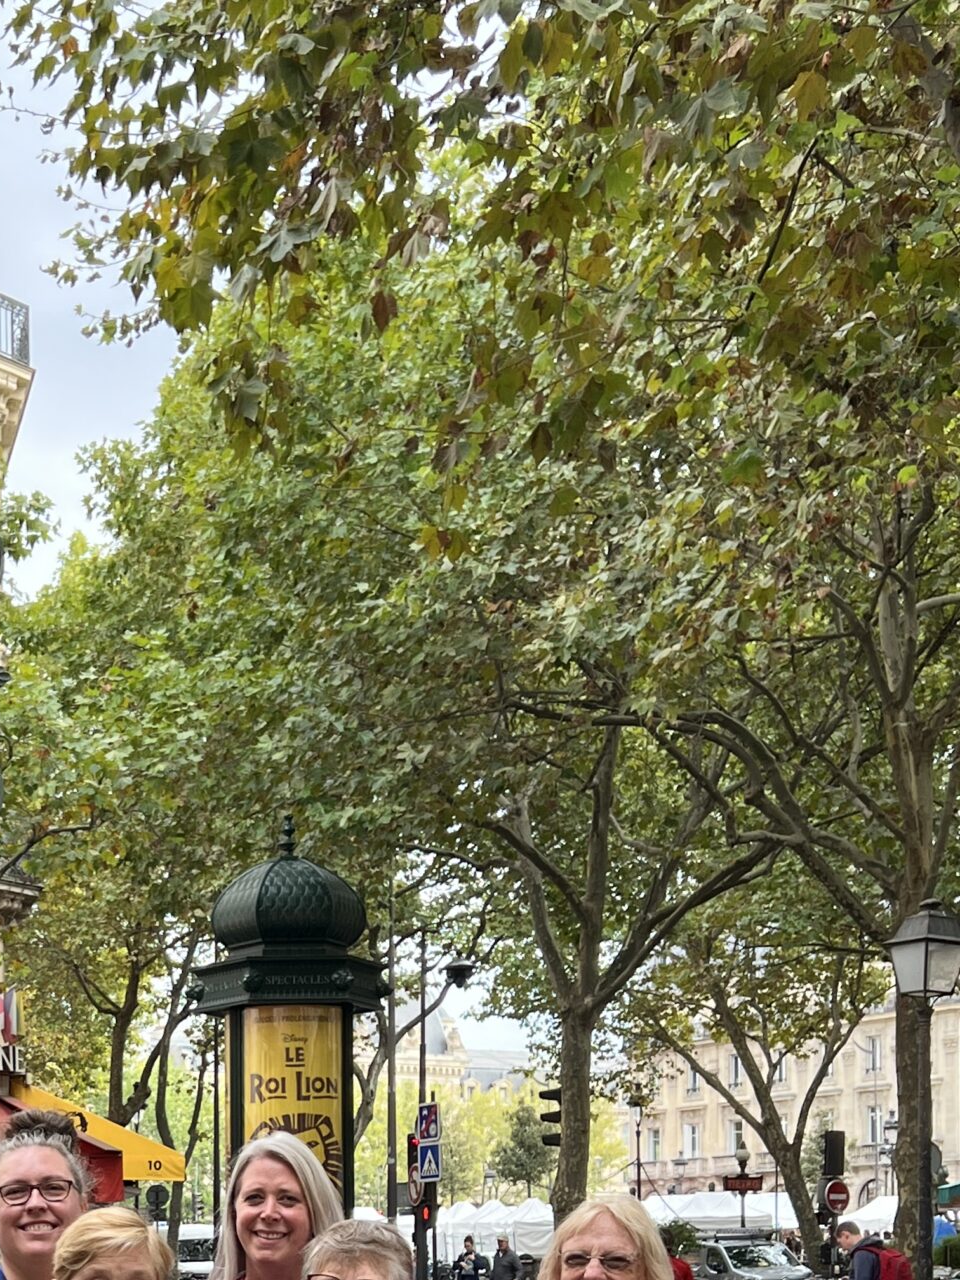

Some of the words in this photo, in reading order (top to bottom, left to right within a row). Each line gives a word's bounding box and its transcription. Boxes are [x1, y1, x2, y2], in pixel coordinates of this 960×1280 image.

[264, 974, 331, 986] SPECTACLES
[281, 1032, 308, 1045] Disney
[285, 1046, 305, 1063] LE
[249, 1073, 287, 1104] ROI
[295, 1071, 338, 1101] LION
[147, 1160, 162, 1171] 10
